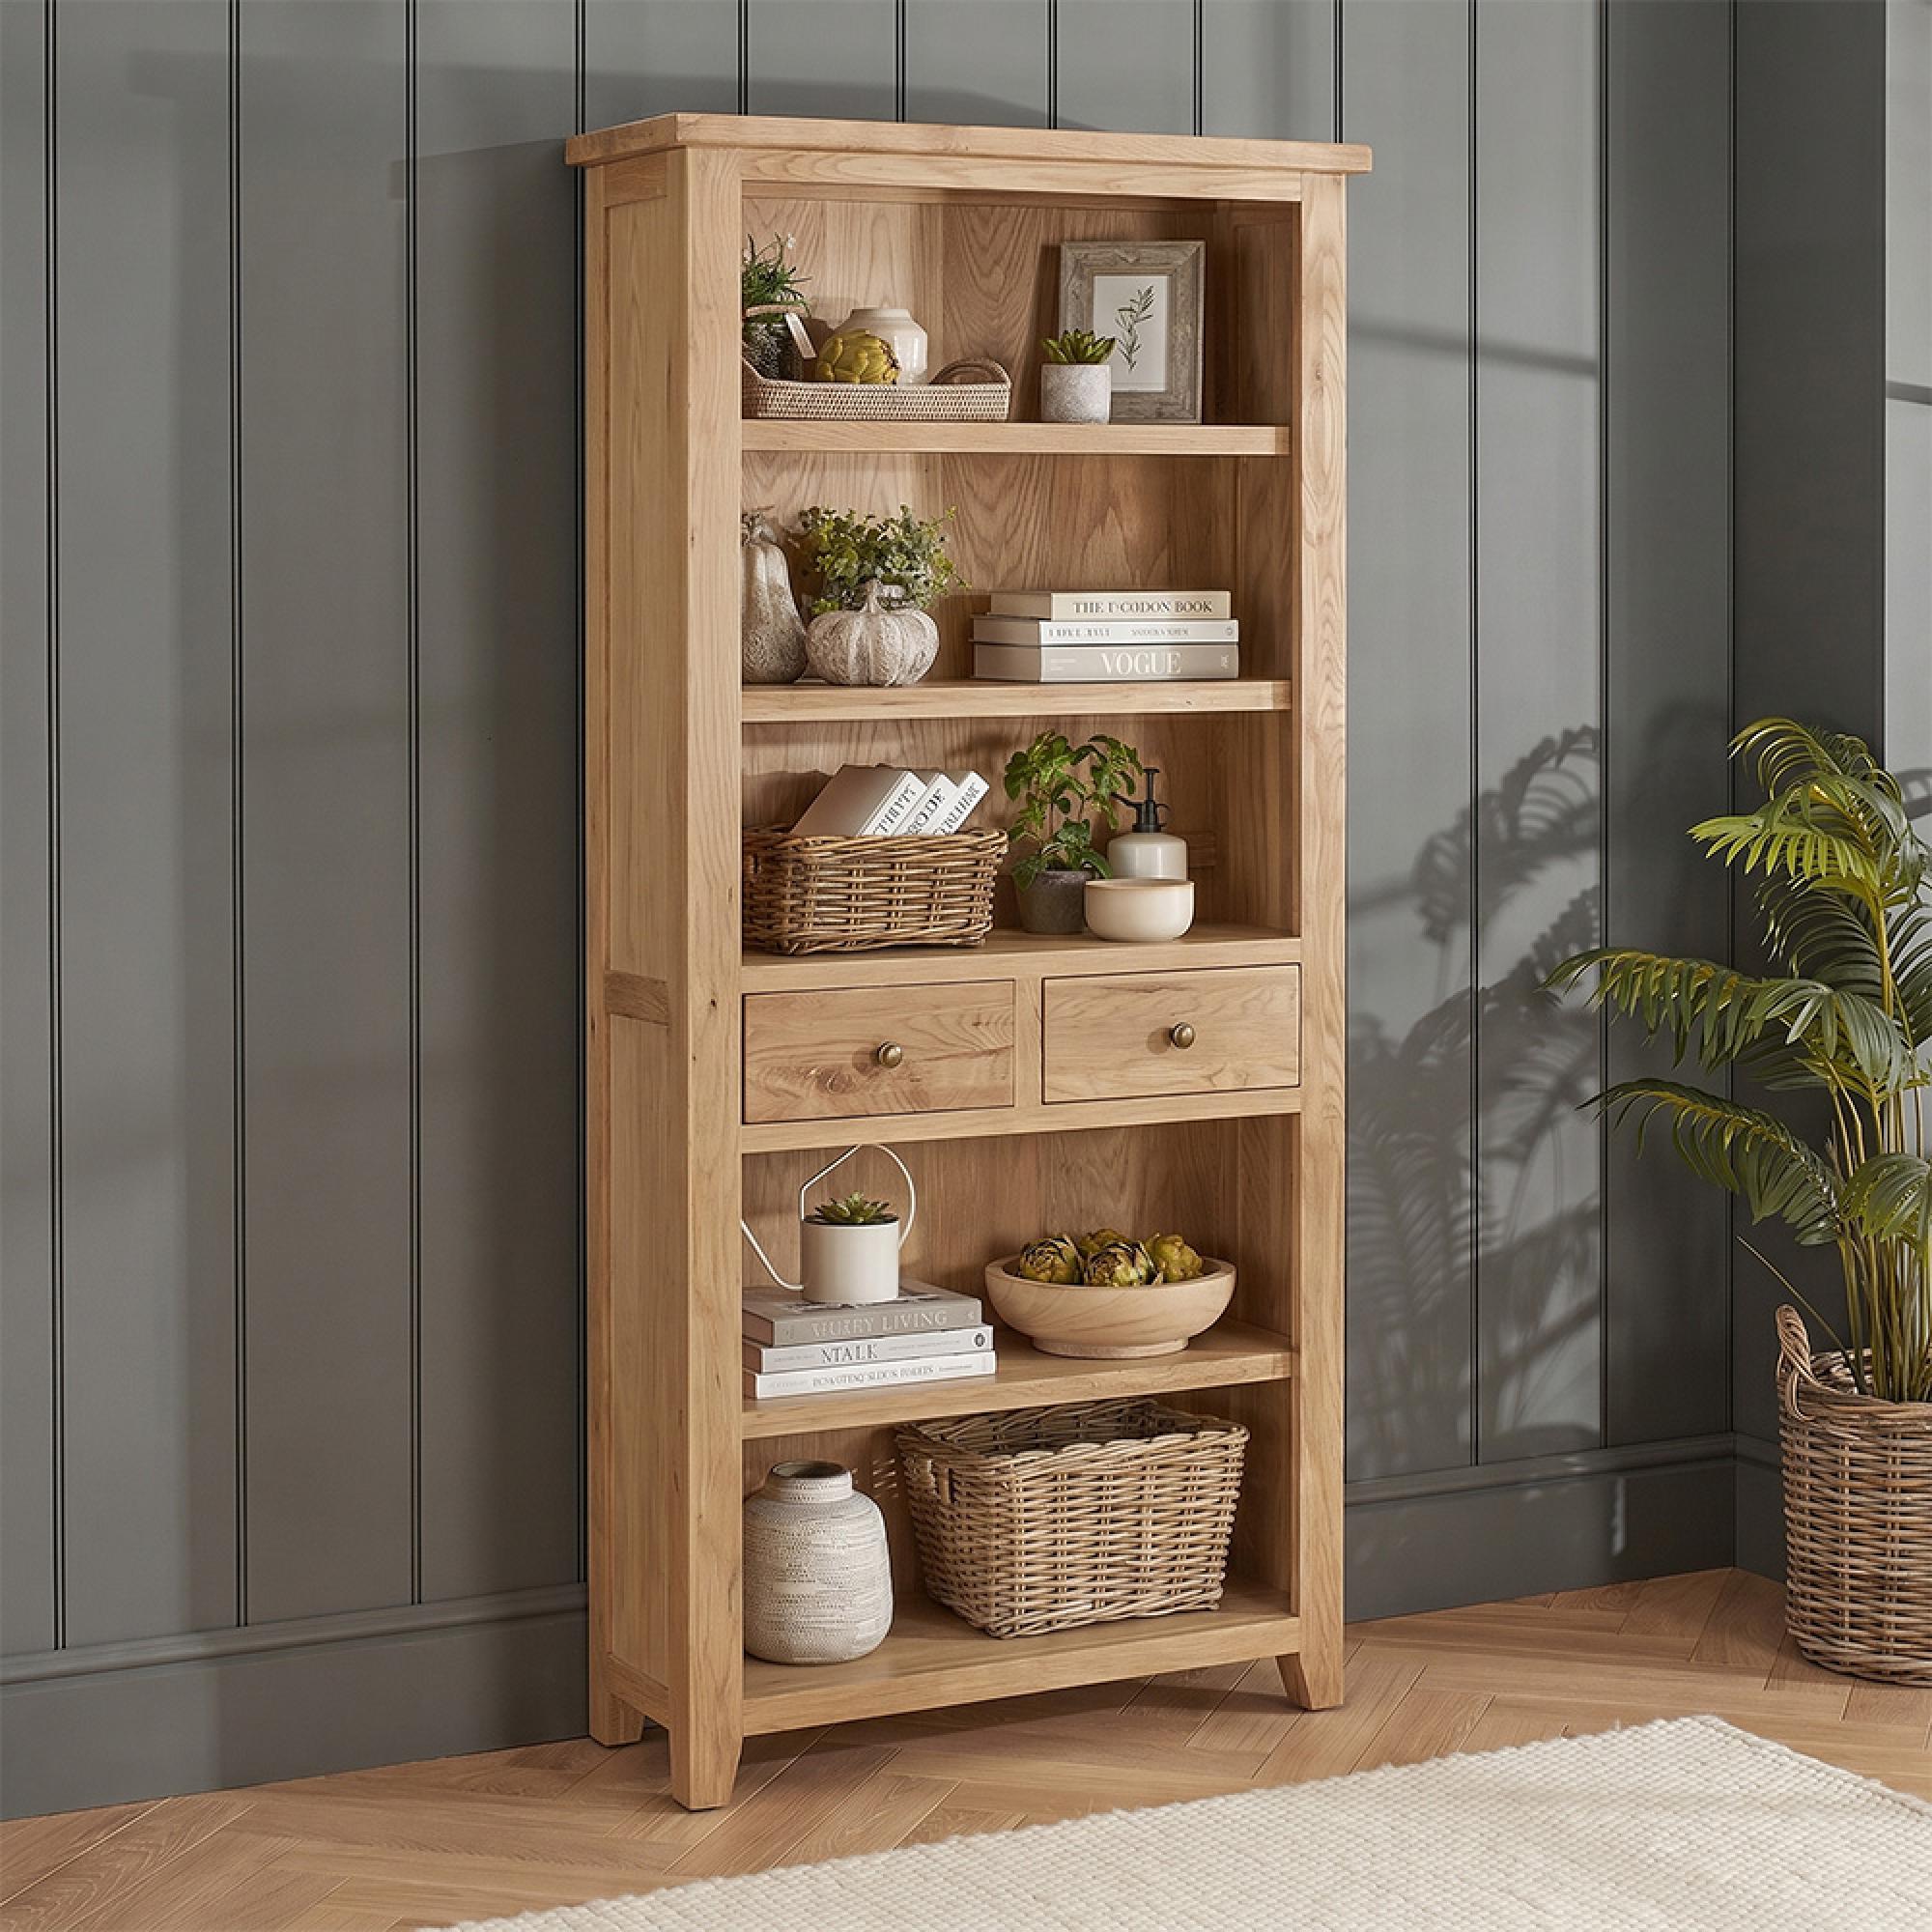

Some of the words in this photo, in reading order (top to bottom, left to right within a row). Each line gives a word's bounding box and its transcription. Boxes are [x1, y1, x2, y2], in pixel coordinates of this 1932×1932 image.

[1072, 601, 1104, 613] THE
[1174, 600, 1213, 613] BOOK
[1100, 652, 1182, 675] VOGUE
[882, 1310, 949, 1331] LIVING
